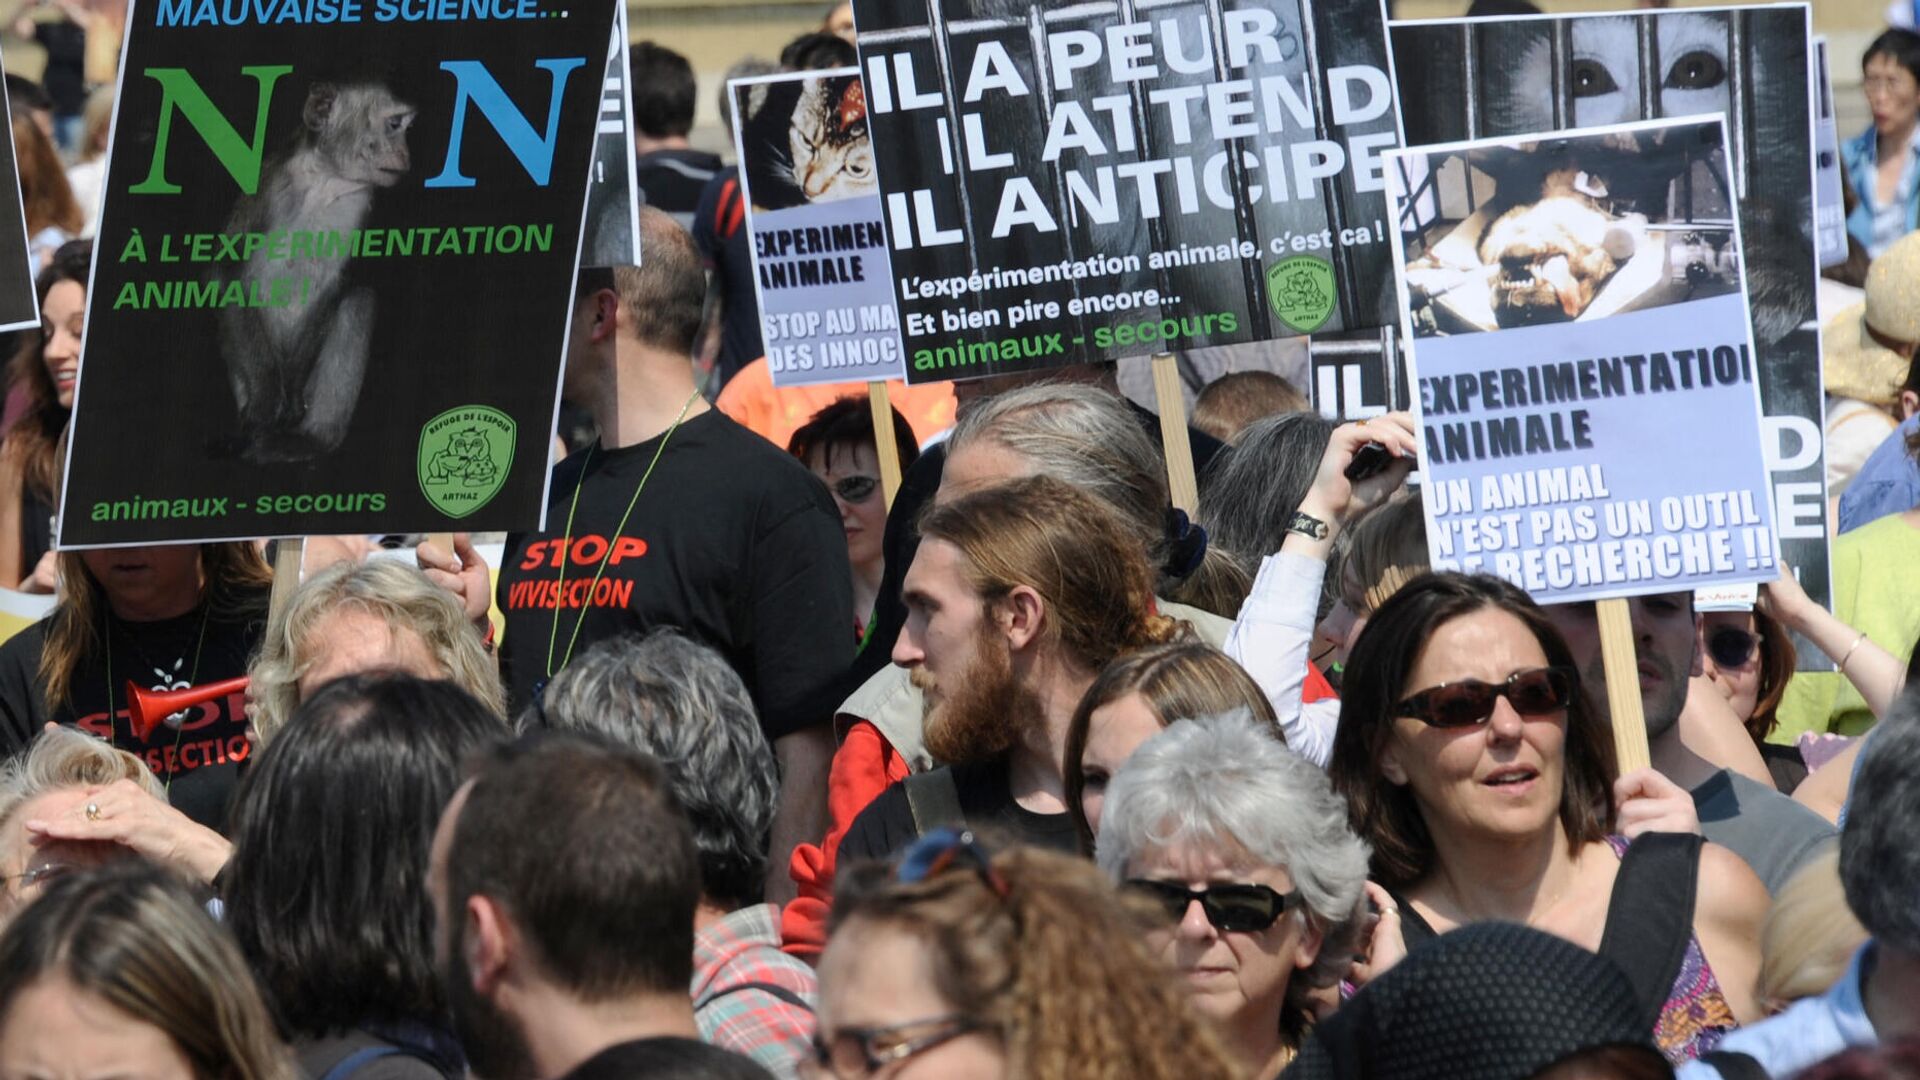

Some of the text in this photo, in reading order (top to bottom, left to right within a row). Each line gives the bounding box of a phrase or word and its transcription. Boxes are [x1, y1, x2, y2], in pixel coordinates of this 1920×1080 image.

[155, 0, 362, 26] MAUVAISE
[866, 7, 1284, 114] IL A PEUR
[128, 65, 294, 195] N
[424, 57, 587, 187] N
[936, 65, 1392, 175] IL ATTEND
[887, 132, 1397, 251] IL ANTICIPE
[119, 223, 554, 263] À L'EXPÉRIMENTATION
[901, 253, 1140, 300] L'expérimentation
[1148, 237, 1262, 269] animale,
[1270, 228, 1333, 254] c'est
[1340, 227, 1371, 246] ca
[113, 275, 294, 310] ANIMALE
[759, 255, 865, 290] ANIMALE
[765, 310, 822, 341] STOP
[826, 308, 856, 336] AU
[906, 288, 1181, 337] Et bien pire encore...
[769, 343, 815, 373] DES
[914, 332, 1064, 371] animaux
[1094, 311, 1238, 348] secours
[1317, 364, 1388, 420] IL
[1424, 409, 1595, 465] ANIMALE
[91, 495, 228, 521] animaux
[256, 492, 386, 514] secours
[1431, 464, 1609, 517] UN ANIMAL
[1433, 489, 1761, 557] N'EST PAS UN OUTIL
[520, 534, 648, 570] STOP
[1495, 530, 1735, 592] RECHERCHE
[1742, 526, 1775, 570] !!
[508, 577, 635, 610] VIVISECTION
